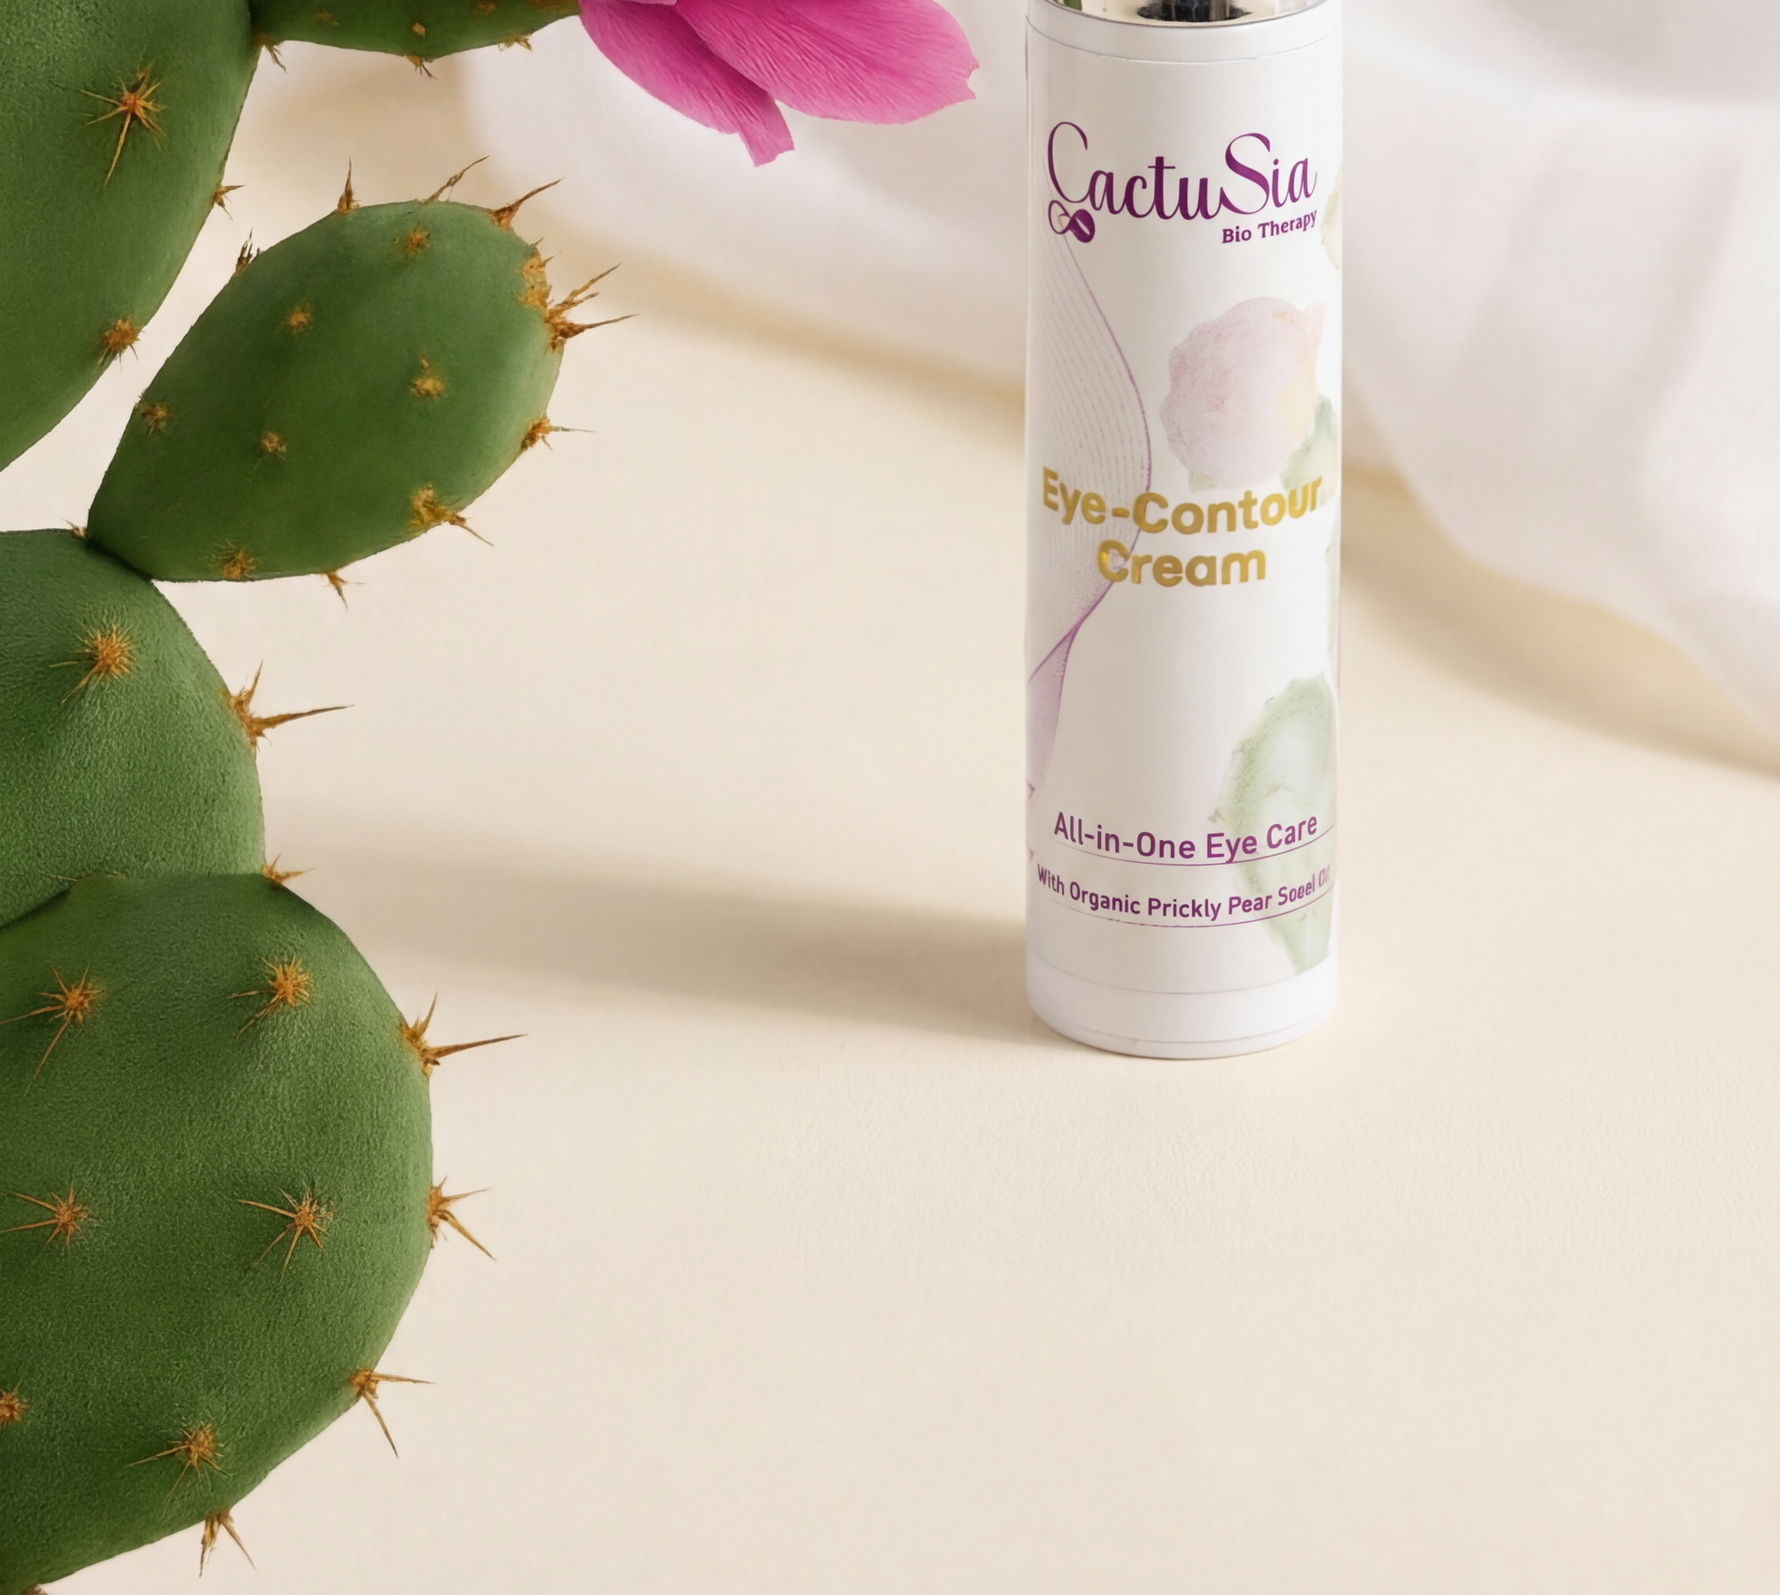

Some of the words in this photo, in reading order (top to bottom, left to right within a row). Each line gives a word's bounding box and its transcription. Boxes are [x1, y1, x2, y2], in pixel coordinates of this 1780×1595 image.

[1047, 121, 1318, 220] CactuSia
[1221, 225, 1252, 244] Bio
[1257, 209, 1318, 239] Therapy
[1043, 466, 1322, 535] Eye-Contour
[1097, 540, 1266, 588] Cream
[1053, 811, 1196, 859] All-in-One
[1206, 832, 1258, 864] Eye
[1266, 815, 1318, 850] Care
[1037, 863, 1065, 896] With
[1069, 881, 1141, 915] Organic
[1147, 894, 1222, 922] Prickly
[1228, 893, 1273, 916] Pear
